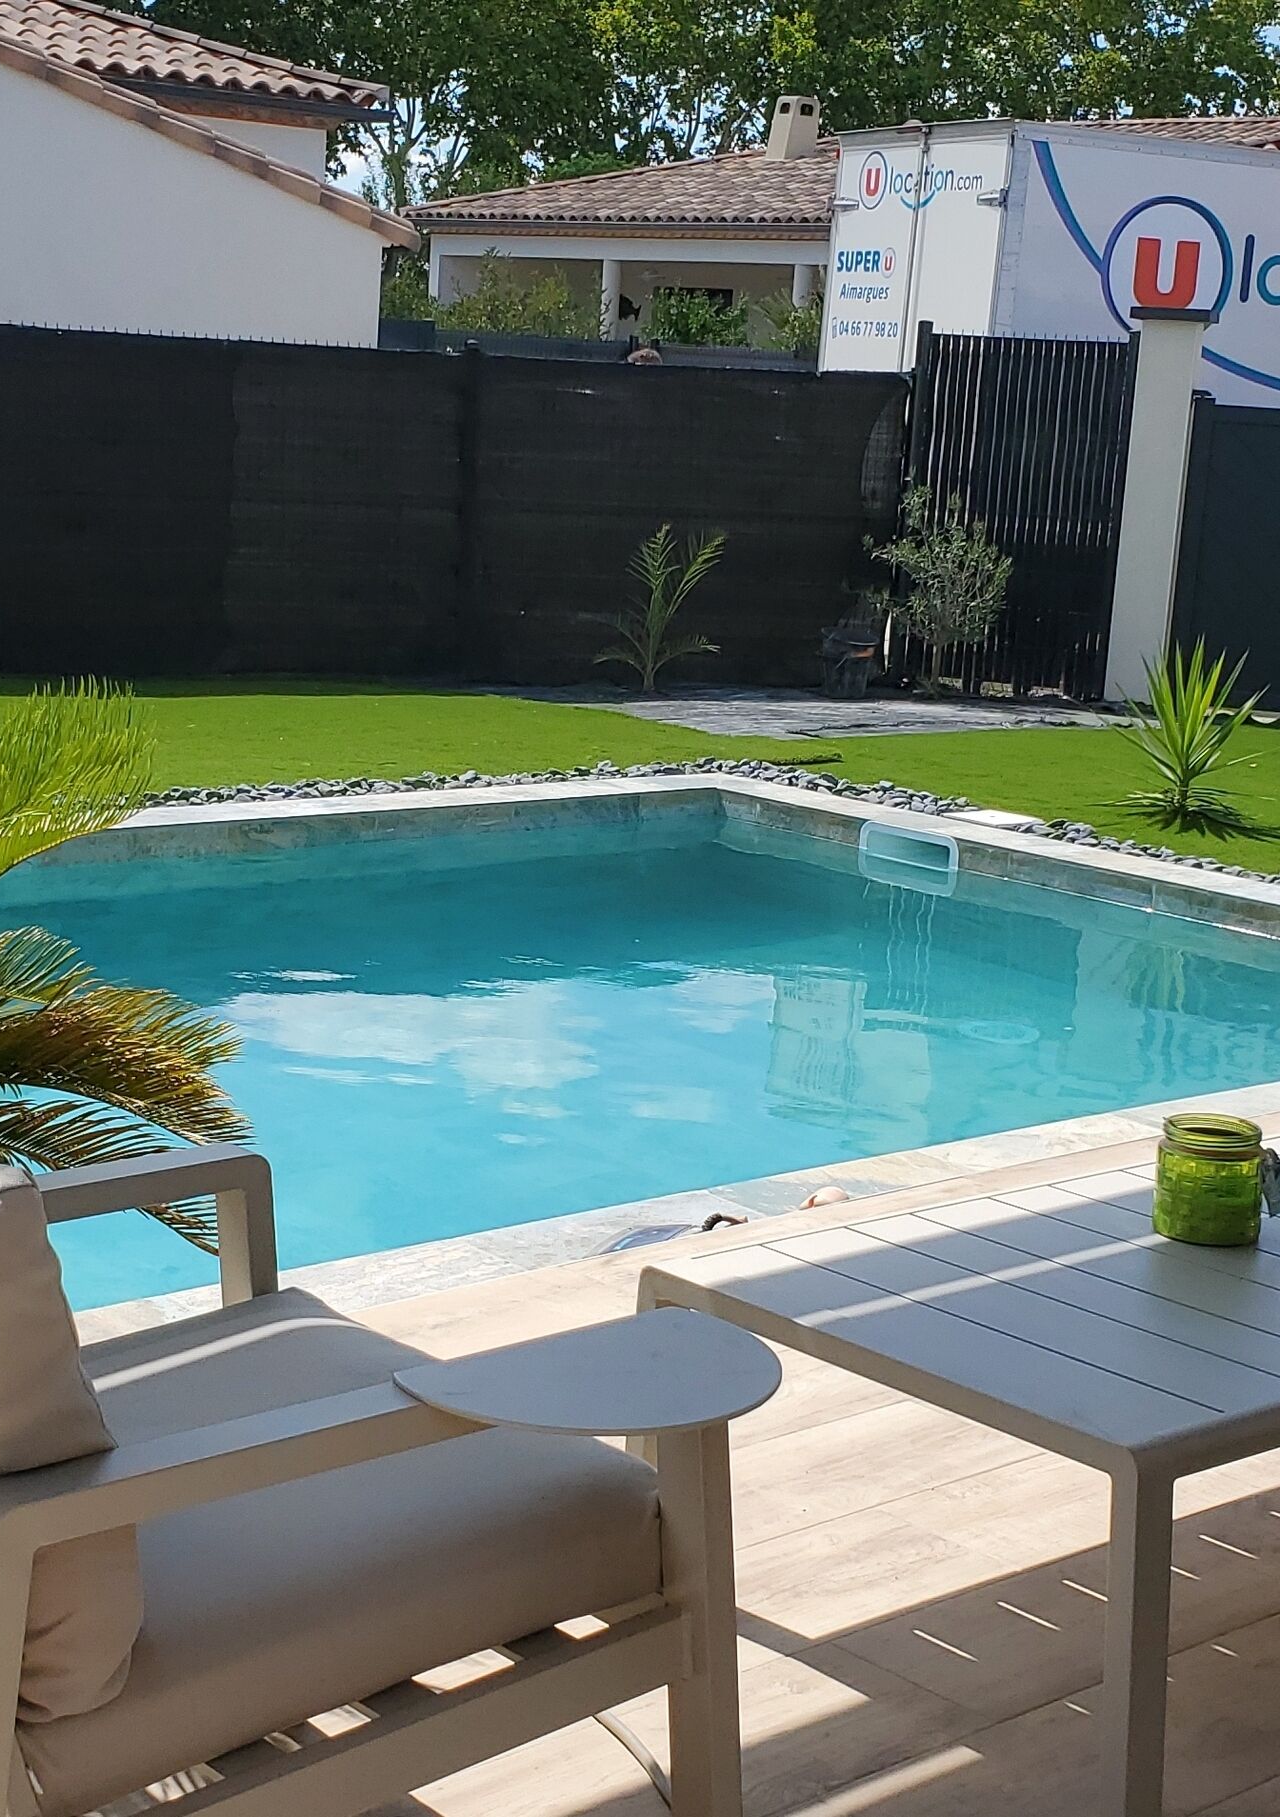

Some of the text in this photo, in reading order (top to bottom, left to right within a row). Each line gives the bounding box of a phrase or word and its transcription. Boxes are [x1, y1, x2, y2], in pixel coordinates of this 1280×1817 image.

[865, 167, 881, 197] U
[837, 250, 893, 273] SUPER U
[1132, 236, 1201, 309] U
[839, 282, 890, 303] Aimargues
[839, 320, 898, 338] 04 66 77 98 20
